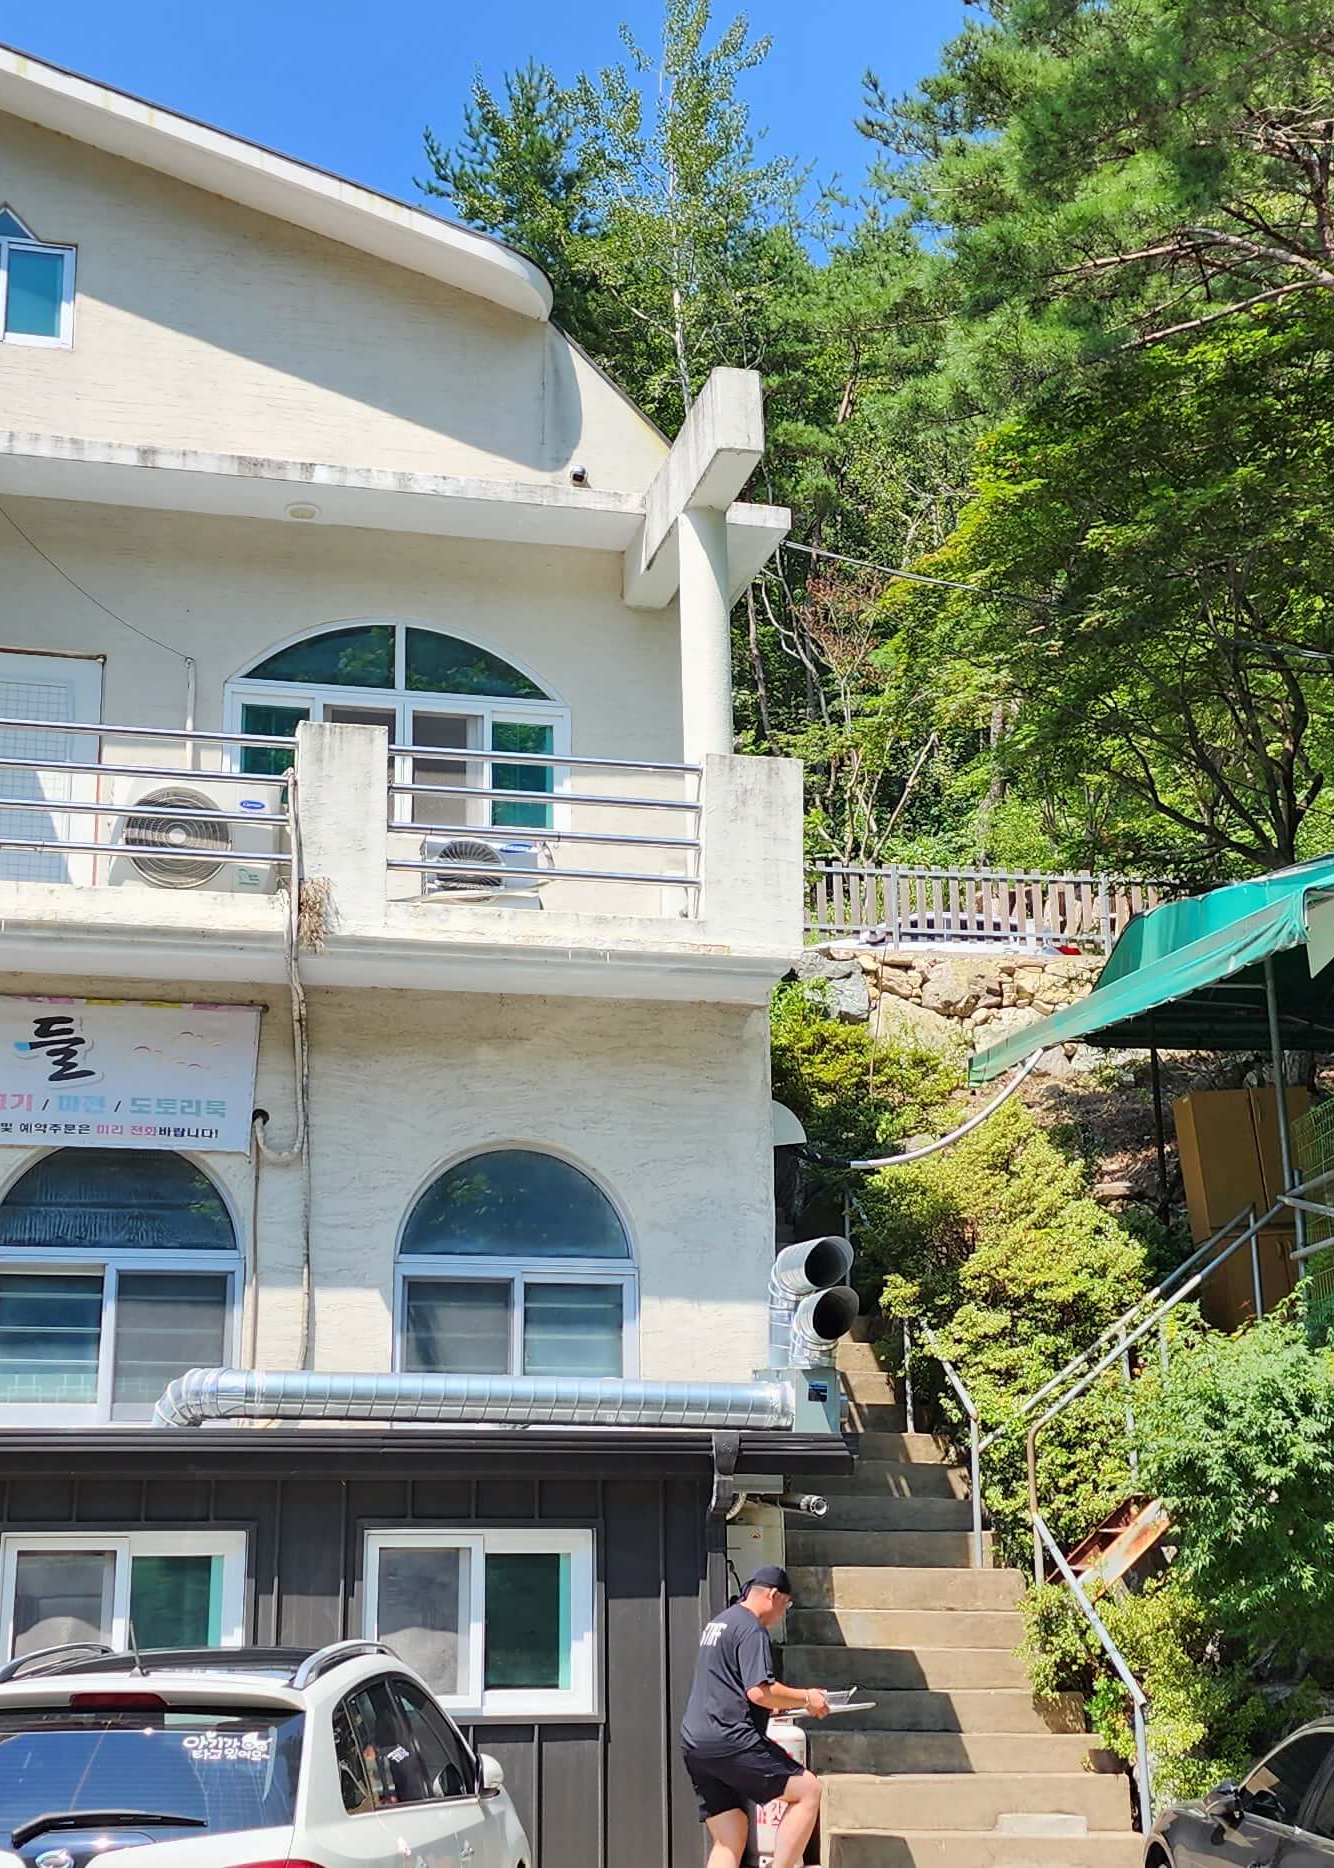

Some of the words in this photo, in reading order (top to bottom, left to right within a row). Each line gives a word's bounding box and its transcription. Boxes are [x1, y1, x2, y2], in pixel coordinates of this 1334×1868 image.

[130, 1096, 227, 1118] 도토리묵
[0, 1121, 13, 1134] 및
[19, 1122, 91, 1135] 예약주문은
[97, 1124, 124, 1136] 미리
[182, 1734, 241, 1750] 아기가
[192, 1749, 223, 1761] 타고
